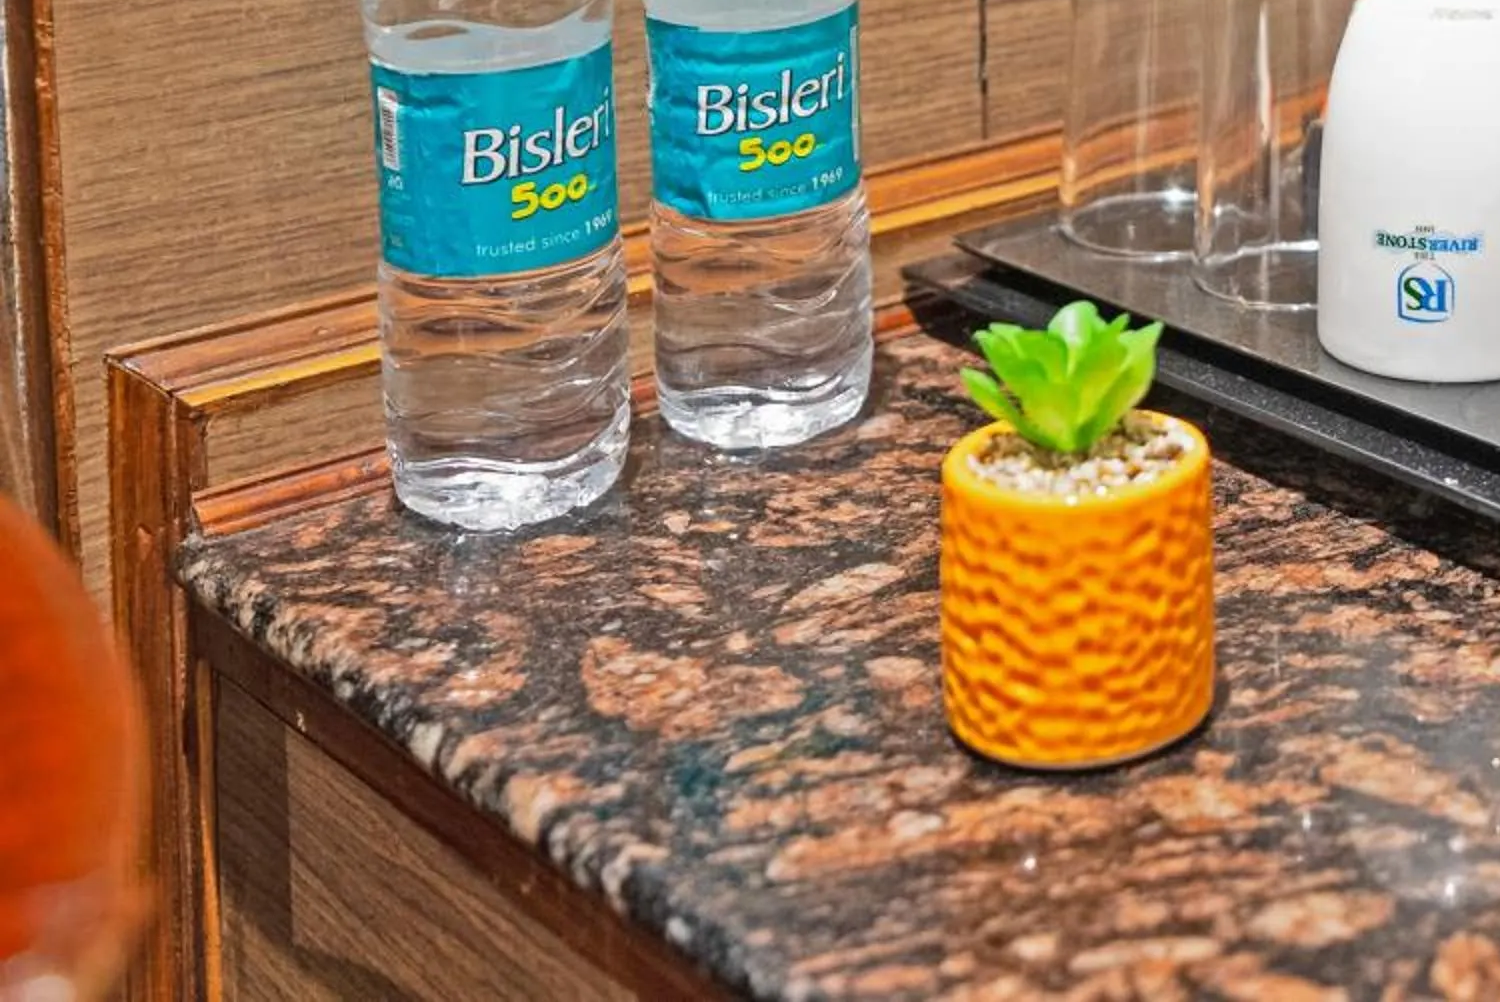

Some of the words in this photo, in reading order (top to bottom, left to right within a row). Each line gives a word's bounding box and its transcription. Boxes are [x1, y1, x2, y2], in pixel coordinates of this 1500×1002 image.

[696, 51, 845, 136] Bisleri
[461, 85, 610, 185] Bisleri
[738, 133, 816, 172] 500
[511, 172, 589, 221] 500
[707, 186, 763, 206] trusted
[767, 182, 807, 199] since
[811, 166, 844, 191] 1969
[476, 236, 537, 258] trusted
[541, 228, 581, 249] since
[583, 207, 614, 236] 1969
[1402, 276, 1448, 313] RS
